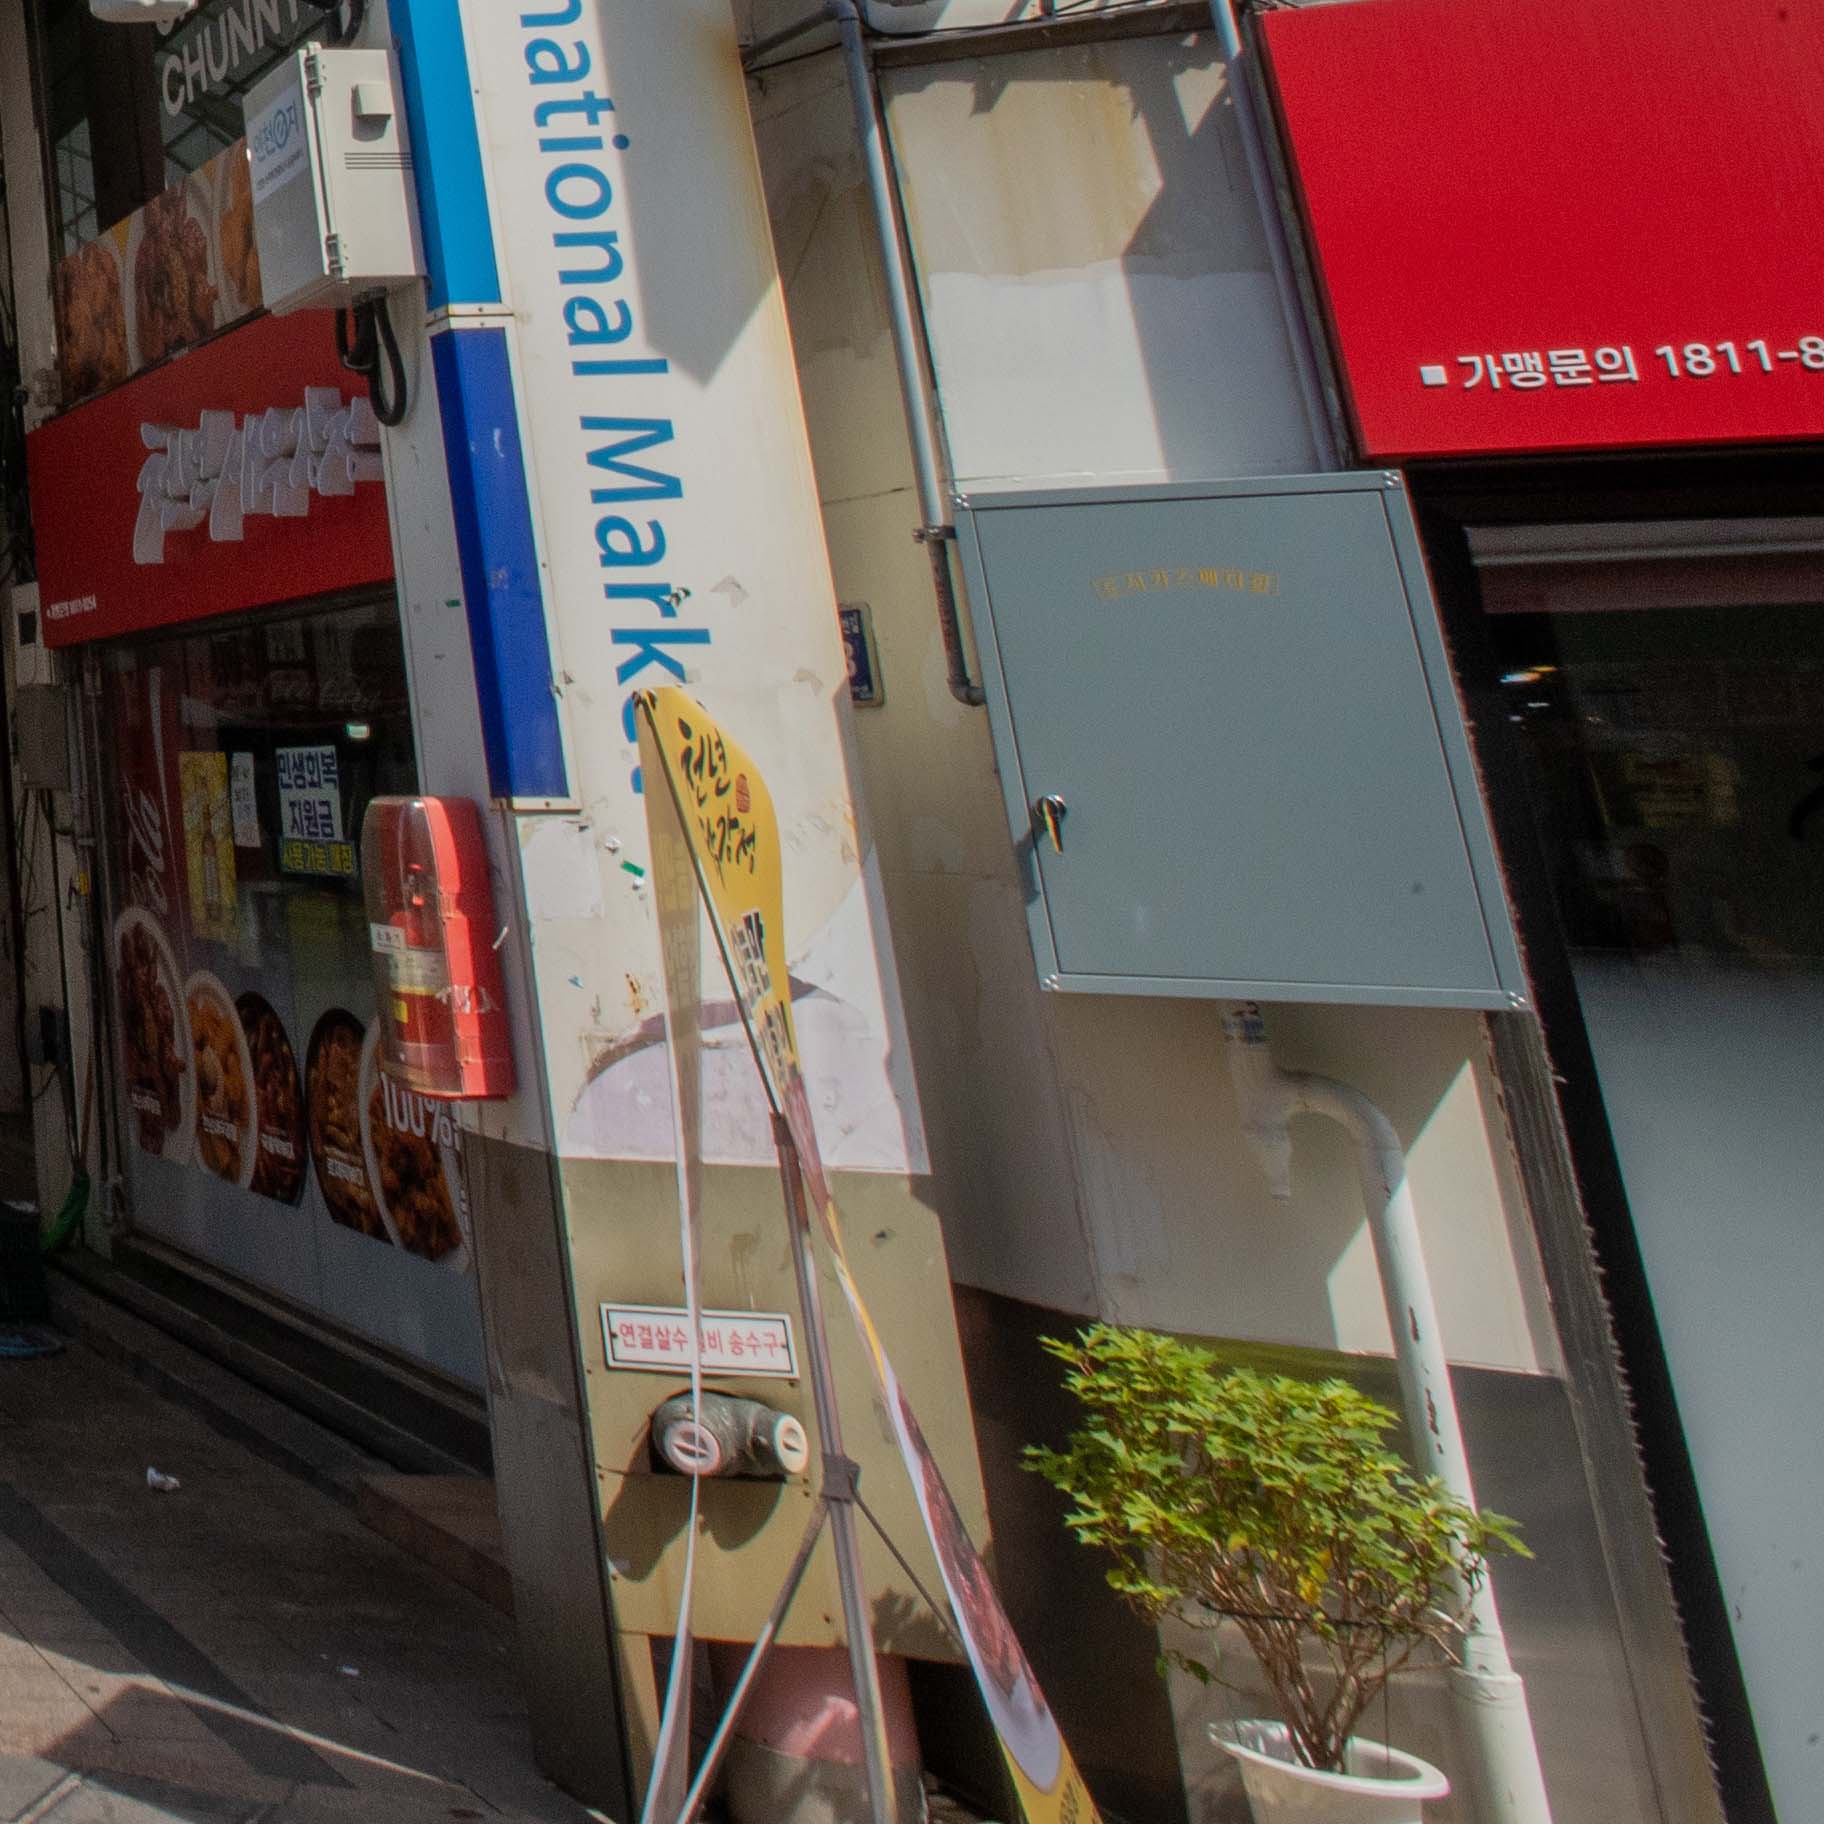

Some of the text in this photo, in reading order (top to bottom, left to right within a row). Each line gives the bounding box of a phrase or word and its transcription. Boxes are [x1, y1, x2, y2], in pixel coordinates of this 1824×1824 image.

[1457, 335, 1824, 392] 가맹문의 1811-8
[277, 750, 338, 790] 민생회복
[288, 799, 336, 838] 지원금
[618, 1321, 689, 1353] 연결살수
[728, 1328, 781, 1359] 송수구
